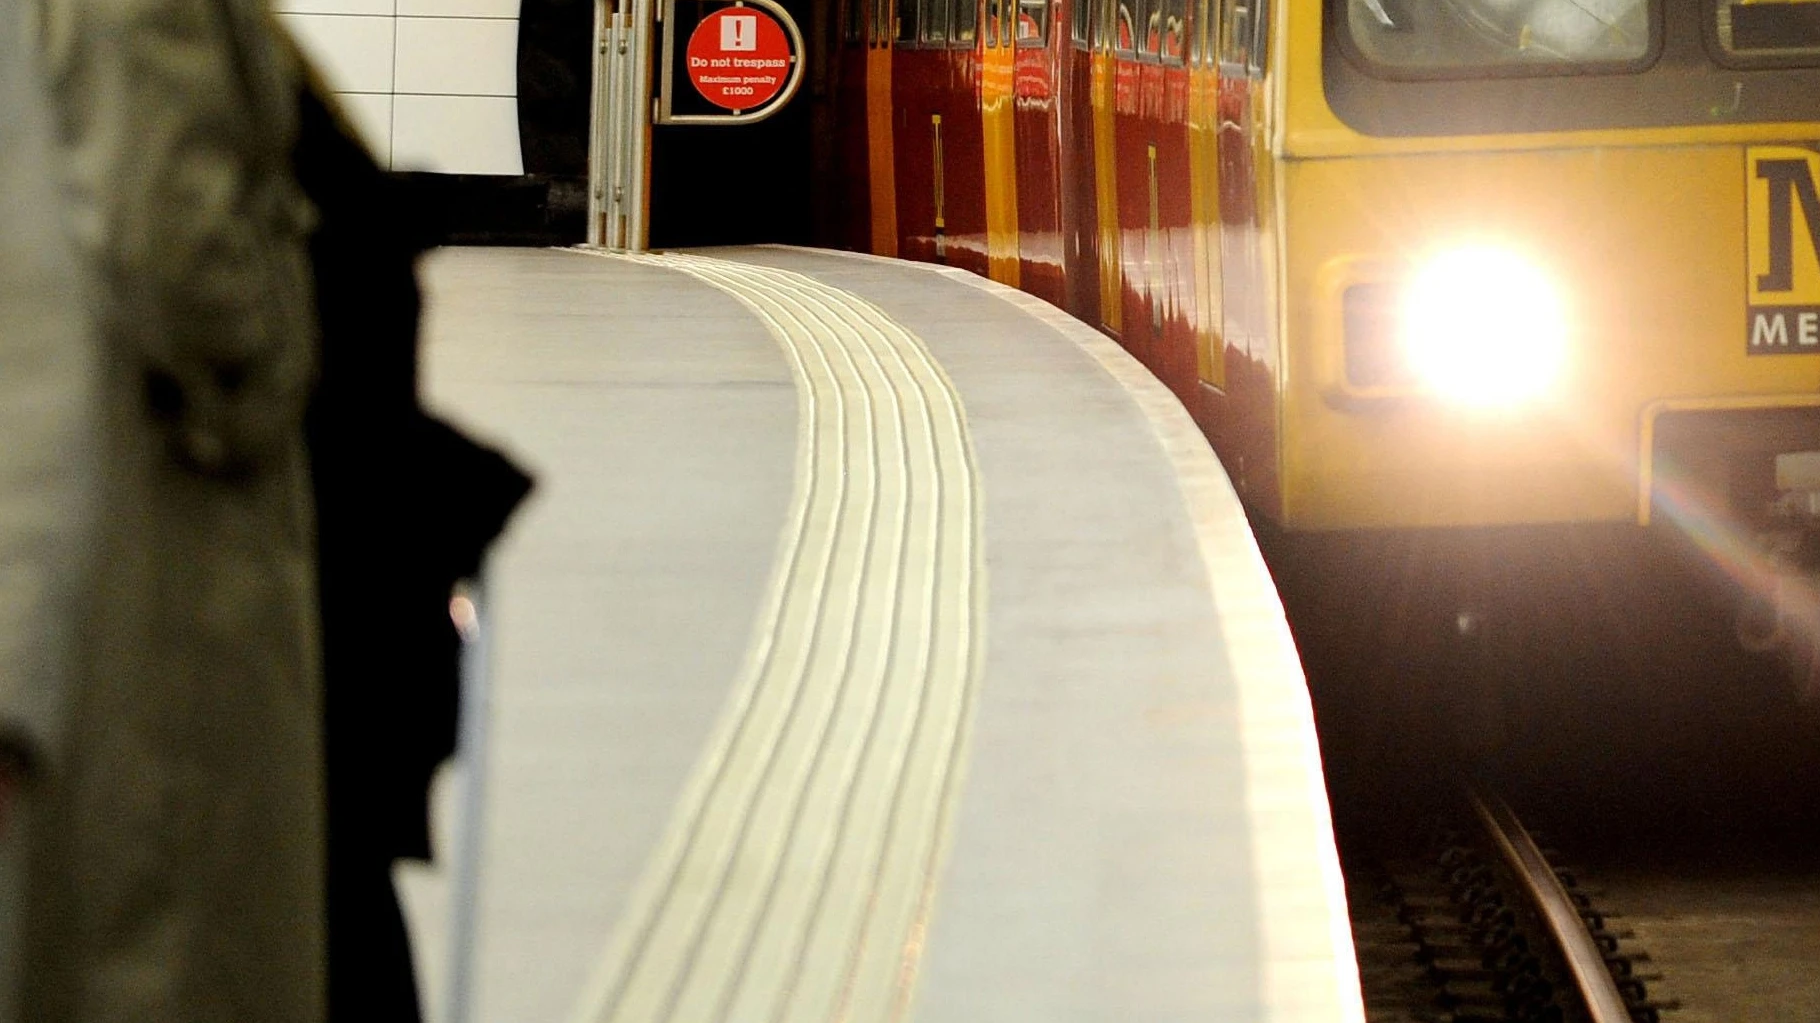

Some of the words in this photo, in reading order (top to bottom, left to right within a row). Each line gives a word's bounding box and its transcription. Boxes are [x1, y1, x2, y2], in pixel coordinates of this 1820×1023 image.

[690, 56, 709, 68] Do
[711, 56, 731, 68] not
[734, 56, 786, 70] trespass
[699, 75, 742, 84] Maximum
[743, 75, 777, 85] penalty
[722, 86, 754, 95] £1000
